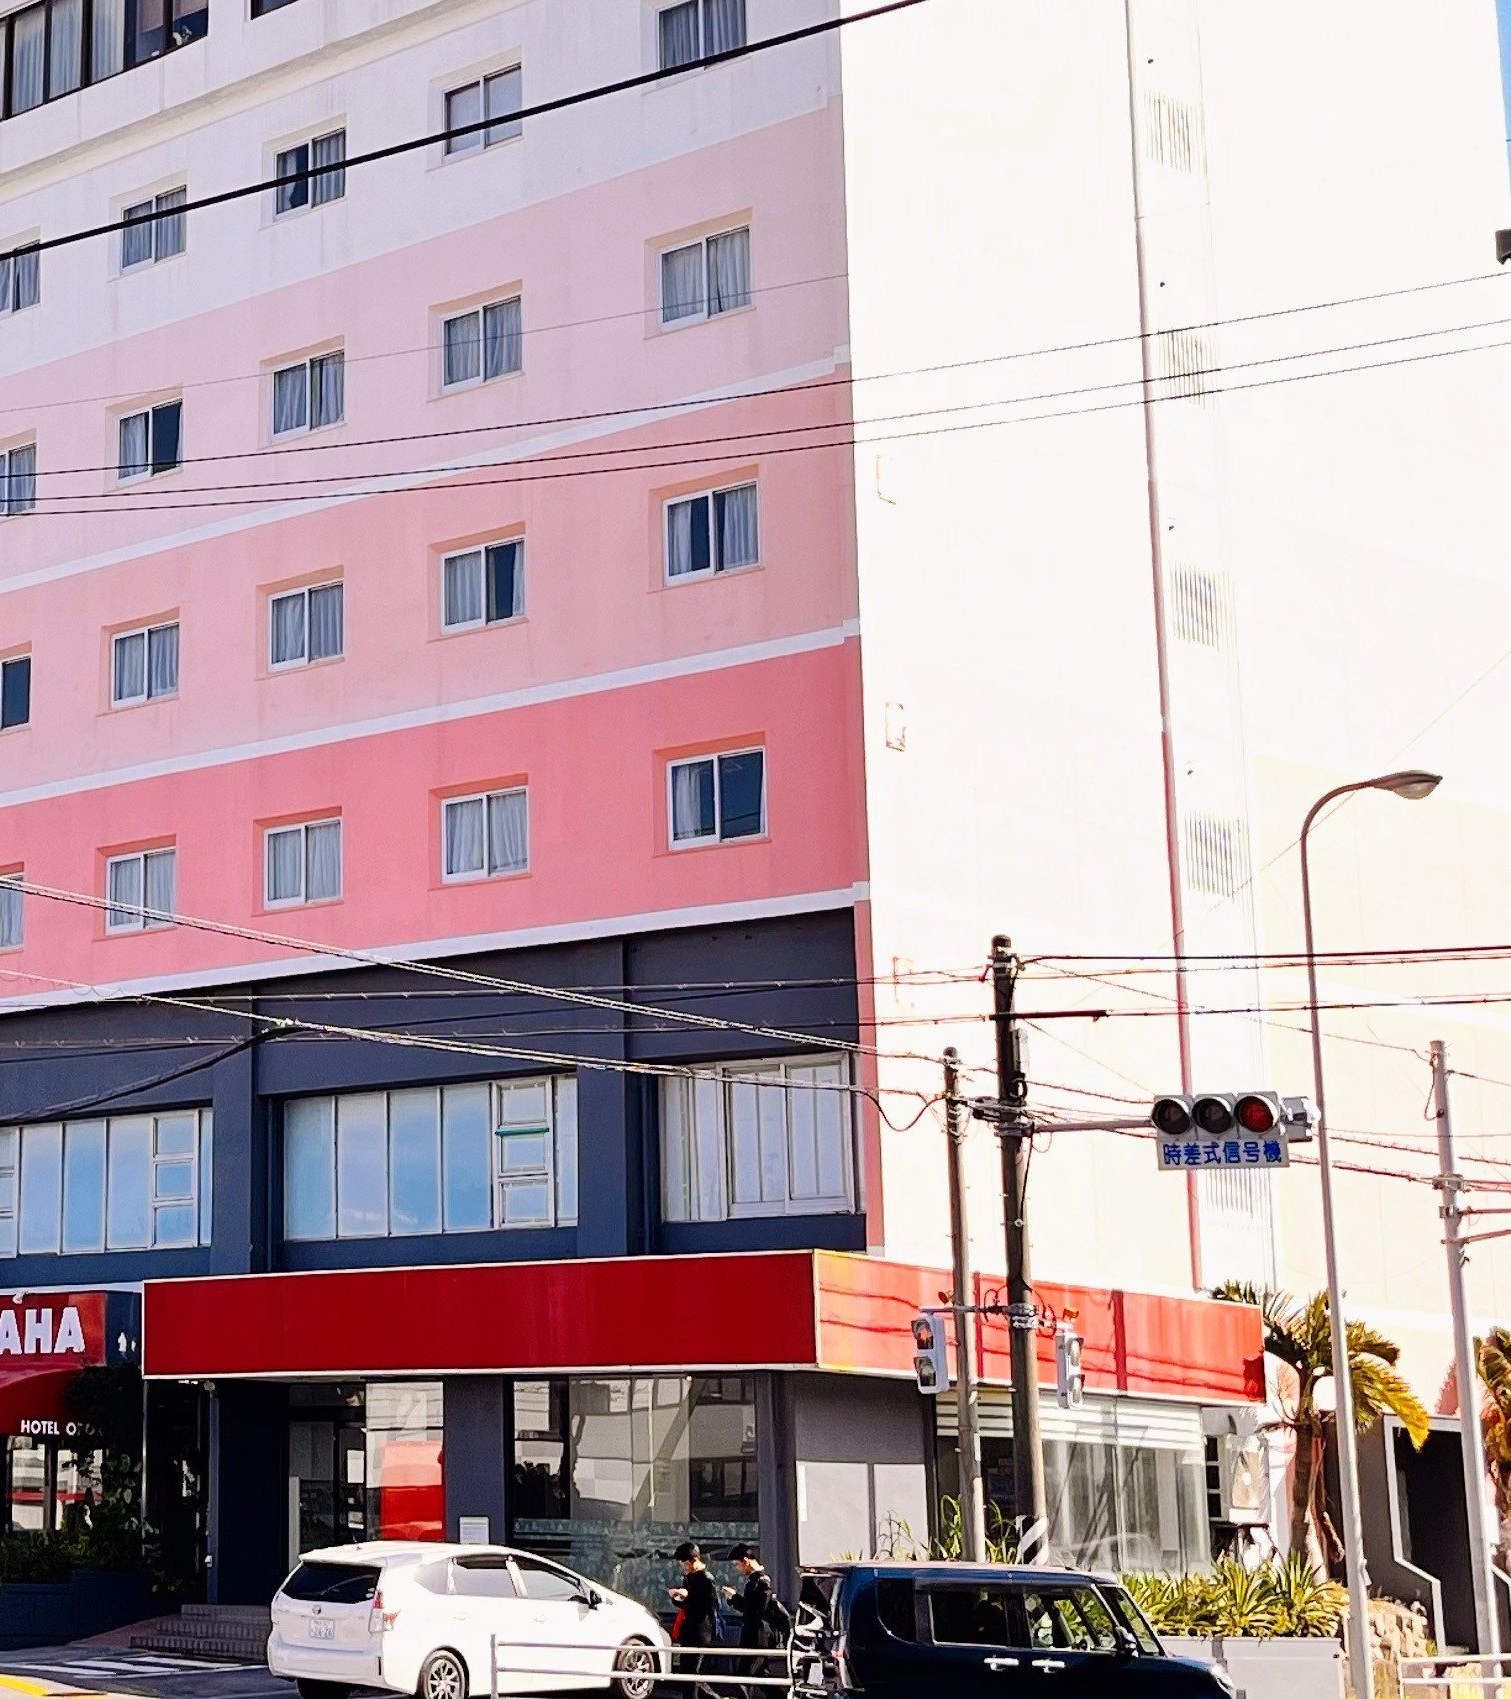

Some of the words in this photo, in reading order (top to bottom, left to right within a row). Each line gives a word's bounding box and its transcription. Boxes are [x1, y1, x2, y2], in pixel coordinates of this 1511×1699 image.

[1163, 1140, 1282, 1165] 時差式信号機
[20, 1419, 60, 1435] HOTEL
